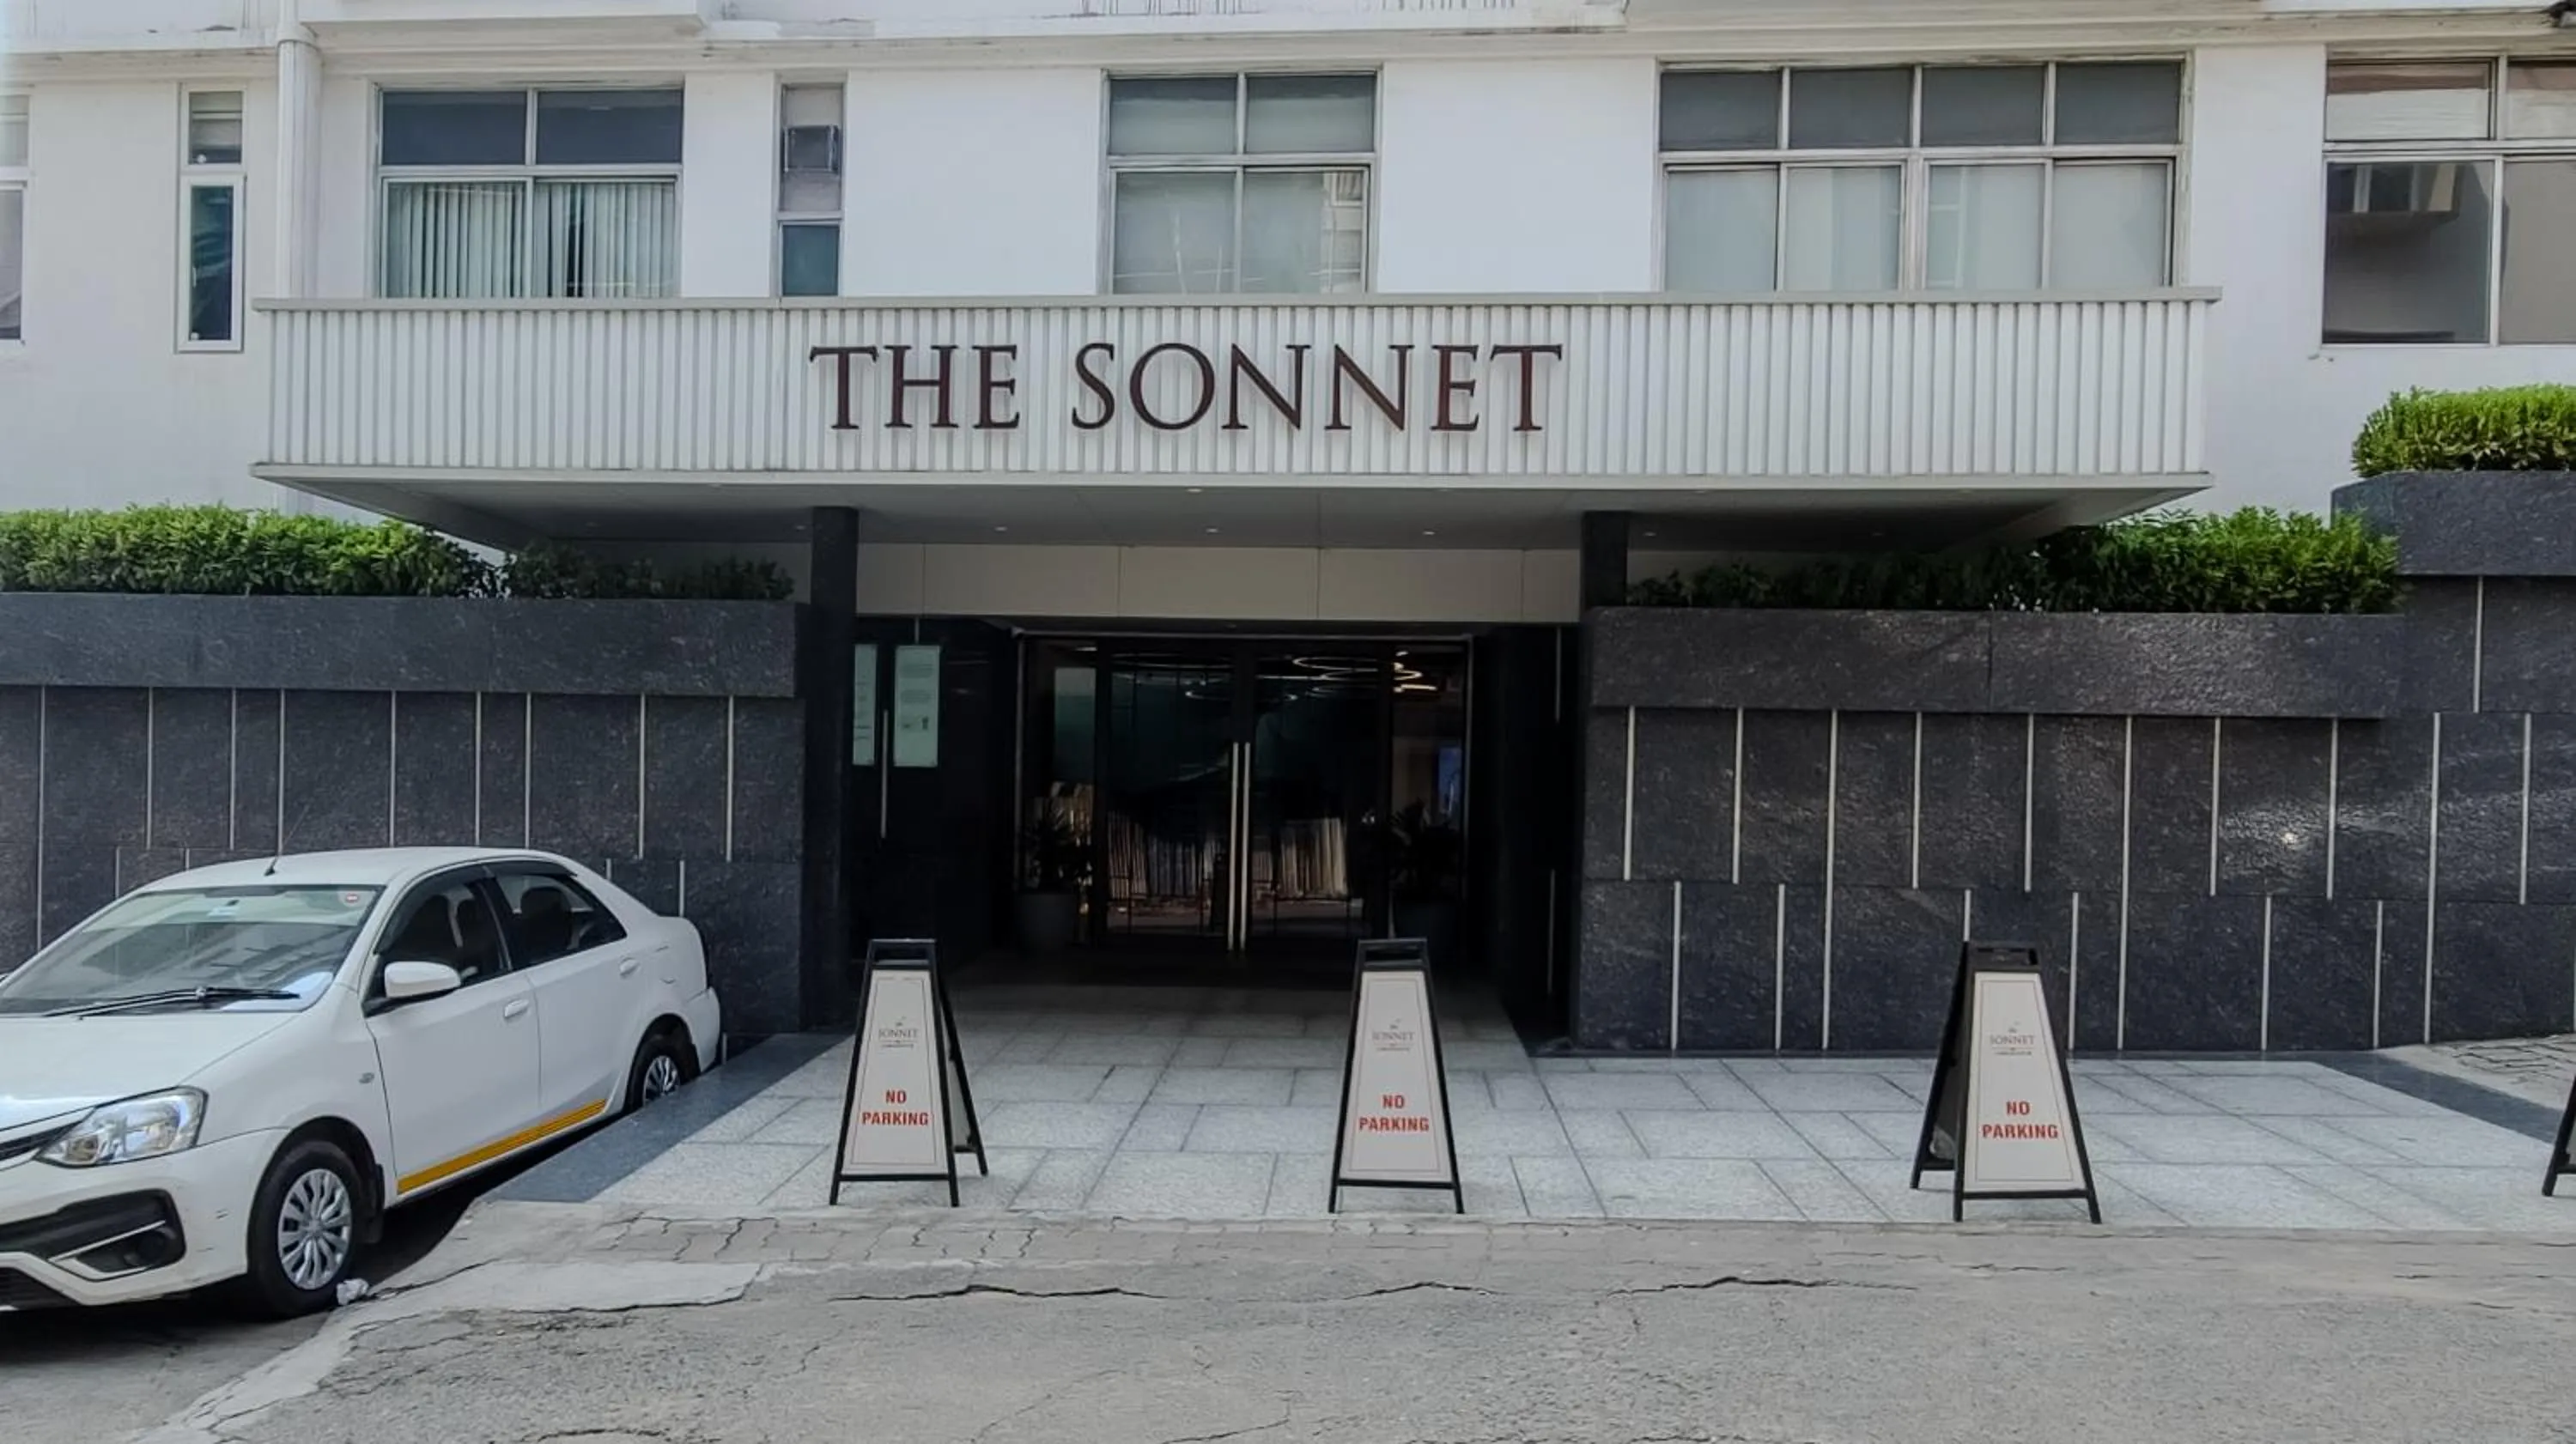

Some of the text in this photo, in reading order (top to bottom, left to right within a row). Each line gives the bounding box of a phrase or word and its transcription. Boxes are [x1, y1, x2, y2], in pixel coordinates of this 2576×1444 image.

[810, 342, 1562, 433] THE SONNET
[885, 1090, 907, 1104] NO
[1382, 1095, 1405, 1109] NO
[2006, 1101, 2030, 1115] NO
[862, 1112, 929, 1126] PARKING
[1359, 1117, 1430, 1132] PARKING
[1982, 1124, 2058, 1139] PARKING
